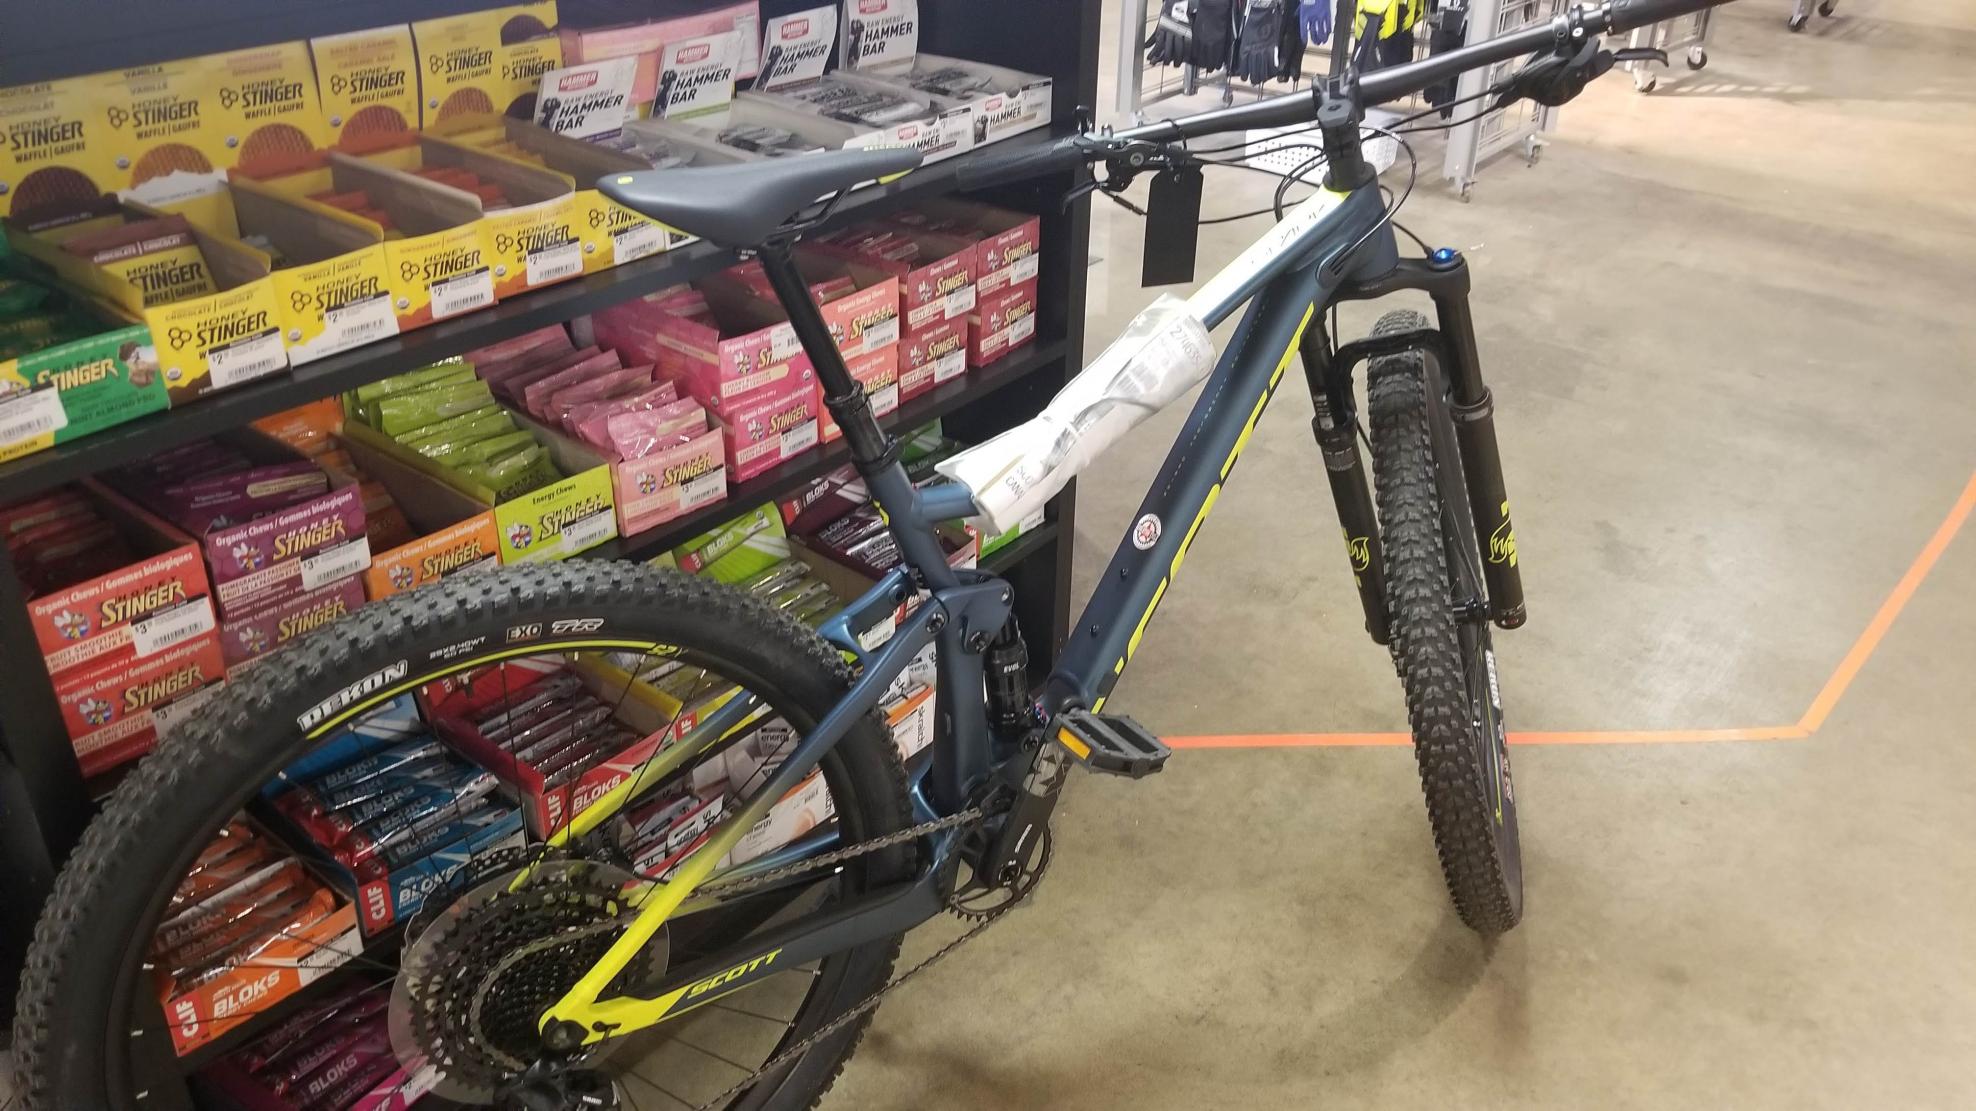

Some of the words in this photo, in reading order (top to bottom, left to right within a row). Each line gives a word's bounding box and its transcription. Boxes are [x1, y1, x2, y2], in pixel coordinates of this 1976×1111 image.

[782, 21, 808, 35] HAMMER
[865, 22, 913, 43] HAMMER
[866, 19, 880, 28] RAW
[882, 15, 904, 26] ENERGY
[446, 46, 480, 58] HONEY
[677, 45, 709, 58] HAMMER
[780, 45, 827, 64] HAMMER
[785, 42, 799, 52] RAW
[800, 39, 821, 48] ENERGY
[862, 43, 886, 57] BAR
[124, 66, 164, 80] VANILLA
[351, 65, 390, 79] HONEY
[445, 51, 493, 74] STINGER
[511, 60, 555, 81] STINGER
[680, 68, 695, 78] RAW
[697, 64, 722, 74] ENERGY
[773, 63, 797, 78] BAR
[242, 77, 286, 92] HONEY
[350, 70, 405, 94] STINGER
[561, 72, 598, 87] HAMMER
[675, 68, 731, 91] HAMMER
[132, 96, 180, 111] HONEY
[242, 83, 303, 108] STINGER
[558, 95, 624, 118] HAMMER
[564, 93, 583, 104] RAW
[585, 89, 614, 101] ENERGY
[670, 88, 697, 105] BAR
[9, 116, 62, 132] HONEY
[133, 101, 199, 127] STINGER
[245, 109, 271, 121] WAFFLE
[555, 115, 584, 132] BAR
[990, 107, 1022, 126] HAMMER
[11, 121, 84, 150] STINGER
[136, 127, 166, 140] WAFFLE
[15, 149, 47, 163] WAFFLE
[516, 224, 569, 253] STINGER
[517, 220, 556, 237] HONEY
[94, 248, 137, 263] CHOCOLATE
[144, 236, 181, 251] CHOCOLAT
[424, 246, 466, 263] HONEY
[127, 257, 179, 277] HONEY
[422, 250, 480, 281] STINGER
[315, 276, 378, 311] STINGER
[316, 273, 361, 293] HONEY
[936, 270, 968, 297] STINGER
[195, 310, 268, 348] STINGER
[196, 308, 248, 330] HONEY
[927, 333, 959, 361] STINGER
[37, 357, 119, 392] STINGER
[769, 404, 808, 435] STINGER
[662, 455, 713, 488] STINGER
[533, 491, 555, 505] Energy
[556, 483, 576, 496] Chews
[806, 480, 830, 505] BLOKS
[215, 531, 248, 548] Organic
[249, 521, 273, 537] Chews
[279, 508, 311, 526] Gommes
[312, 492, 353, 514] biologiques
[286, 513, 340, 540] HONEY
[272, 518, 346, 561] STINGER
[706, 531, 734, 553] BLOKS
[421, 541, 483, 581] STINGER
[35, 597, 70, 617] Organic
[71, 586, 99, 606] Chews
[105, 571, 143, 590] Gommes
[143, 551, 193, 576] biologiques
[221, 569, 267, 593] POMEGRANATE
[100, 580, 187, 629] STINGER
[222, 587, 241, 600] FRUIT
[291, 593, 342, 621] HONEY
[277, 599, 348, 643] STINGER
[508, 625, 540, 640] EXO
[73, 629, 123, 657] SMOOTHIE
[60, 686, 95, 706] Organic
[96, 674, 124, 692] Chews
[129, 658, 164, 679] Gommes
[165, 638, 210, 664] biologiques
[124, 665, 205, 714] STINGER
[573, 774, 621, 810] BLOKS
[367, 886, 386, 920] CLIF
[687, 948, 783, 999] SCOTT
[176, 1000, 199, 1038] CLIF
[213, 970, 280, 1018] BLOKS
[308, 1053, 359, 1095] BLOKS
